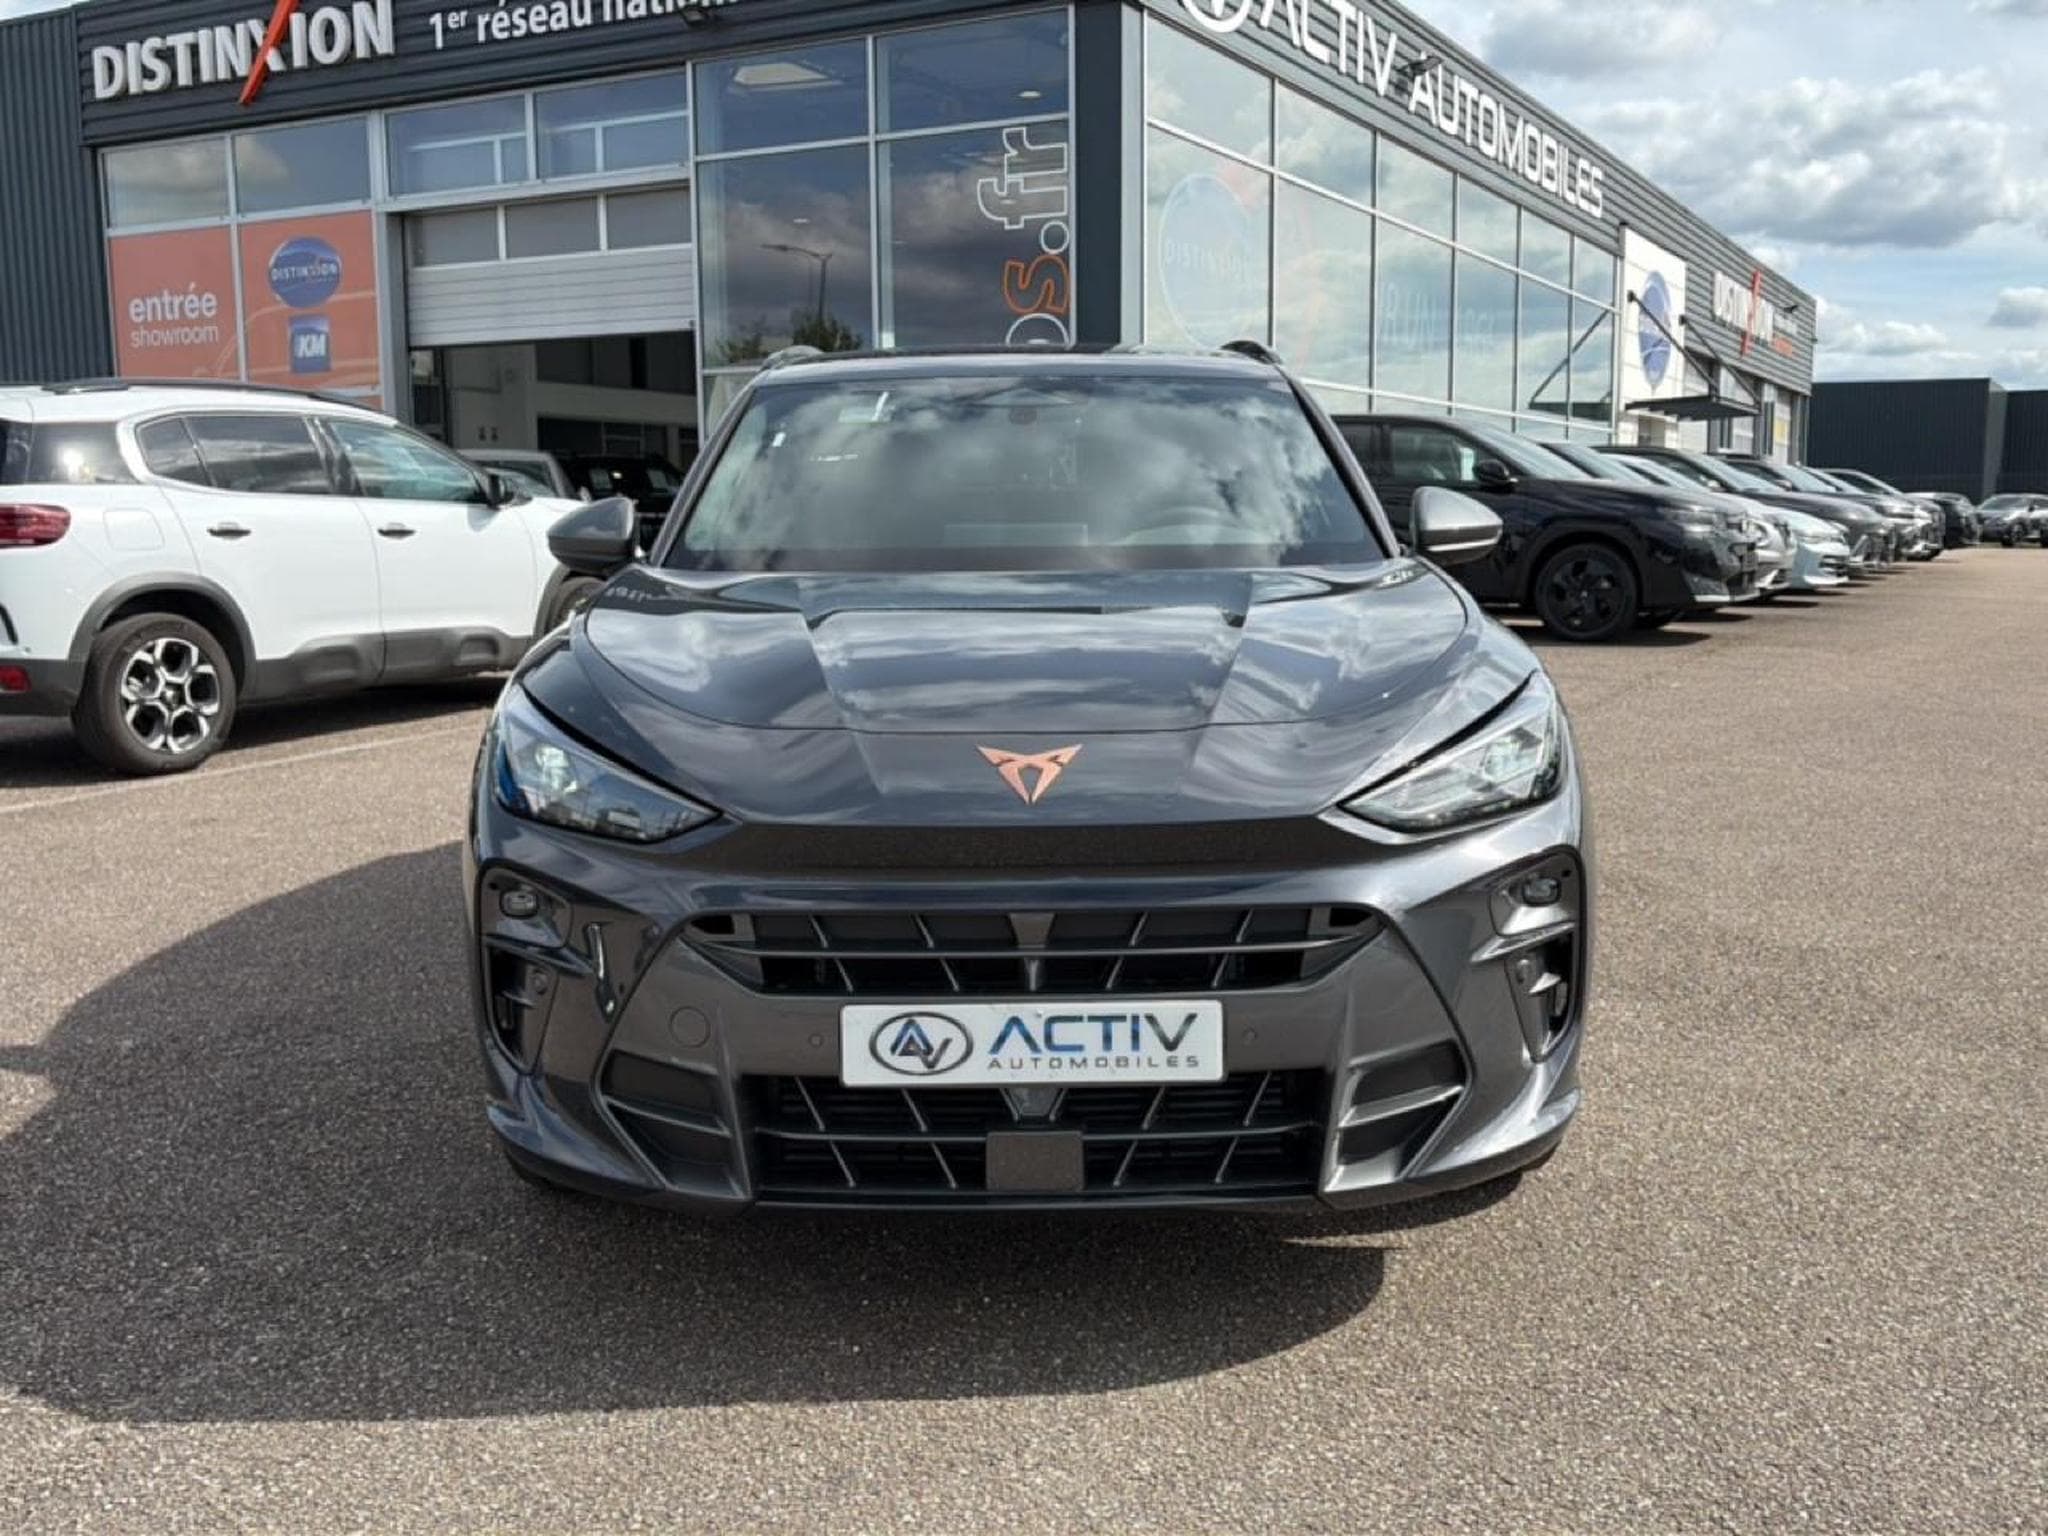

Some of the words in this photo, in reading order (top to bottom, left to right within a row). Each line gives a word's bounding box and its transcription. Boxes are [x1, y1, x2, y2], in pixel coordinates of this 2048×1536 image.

[477, 0, 592, 43] réseau
[92, 0, 396, 103] DISTINXION
[1408, 51, 1603, 219] AUTOMOBILES
[129, 281, 217, 322] entrée
[130, 325, 219, 348] showroom
[988, 1013, 1198, 1055] ACTIV
[987, 1056, 1200, 1070] AUTOMOBILES
